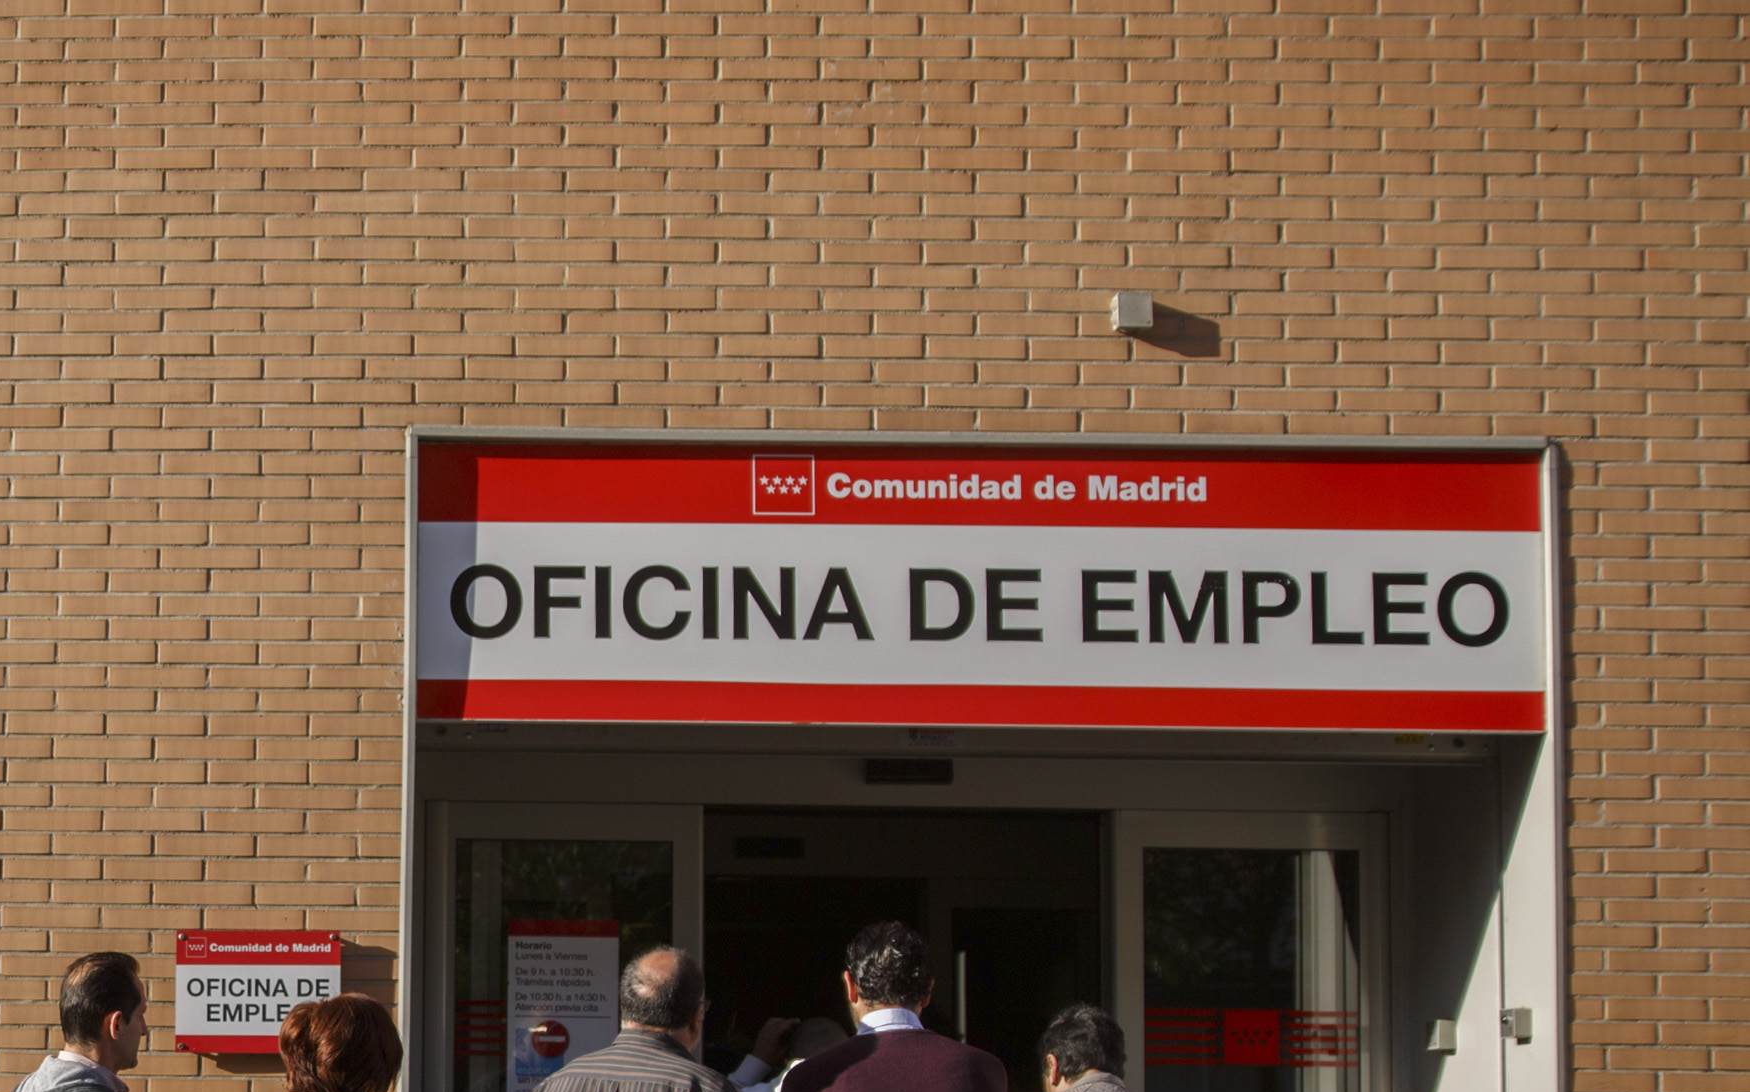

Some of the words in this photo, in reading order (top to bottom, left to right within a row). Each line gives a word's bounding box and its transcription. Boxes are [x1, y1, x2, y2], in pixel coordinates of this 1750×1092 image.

[826, 472, 1022, 501] Comunidad
[1033, 473, 1076, 501] de
[1087, 475, 1208, 503] Madrid
[449, 562, 875, 641] OFICINA
[908, 567, 1044, 643] DE
[1081, 569, 1511, 648] EMPLEO
[209, 943, 272, 953] Comunidad
[275, 943, 289, 953] de
[292, 943, 331, 953] Madrid
[515, 941, 552, 950] Horario
[515, 952, 543, 960] Lunes
[554, 952, 588, 961] Viernes
[186, 978, 289, 997] OFICINA
[297, 978, 330, 997] DE
[206, 1003, 291, 1022] EMPLE
